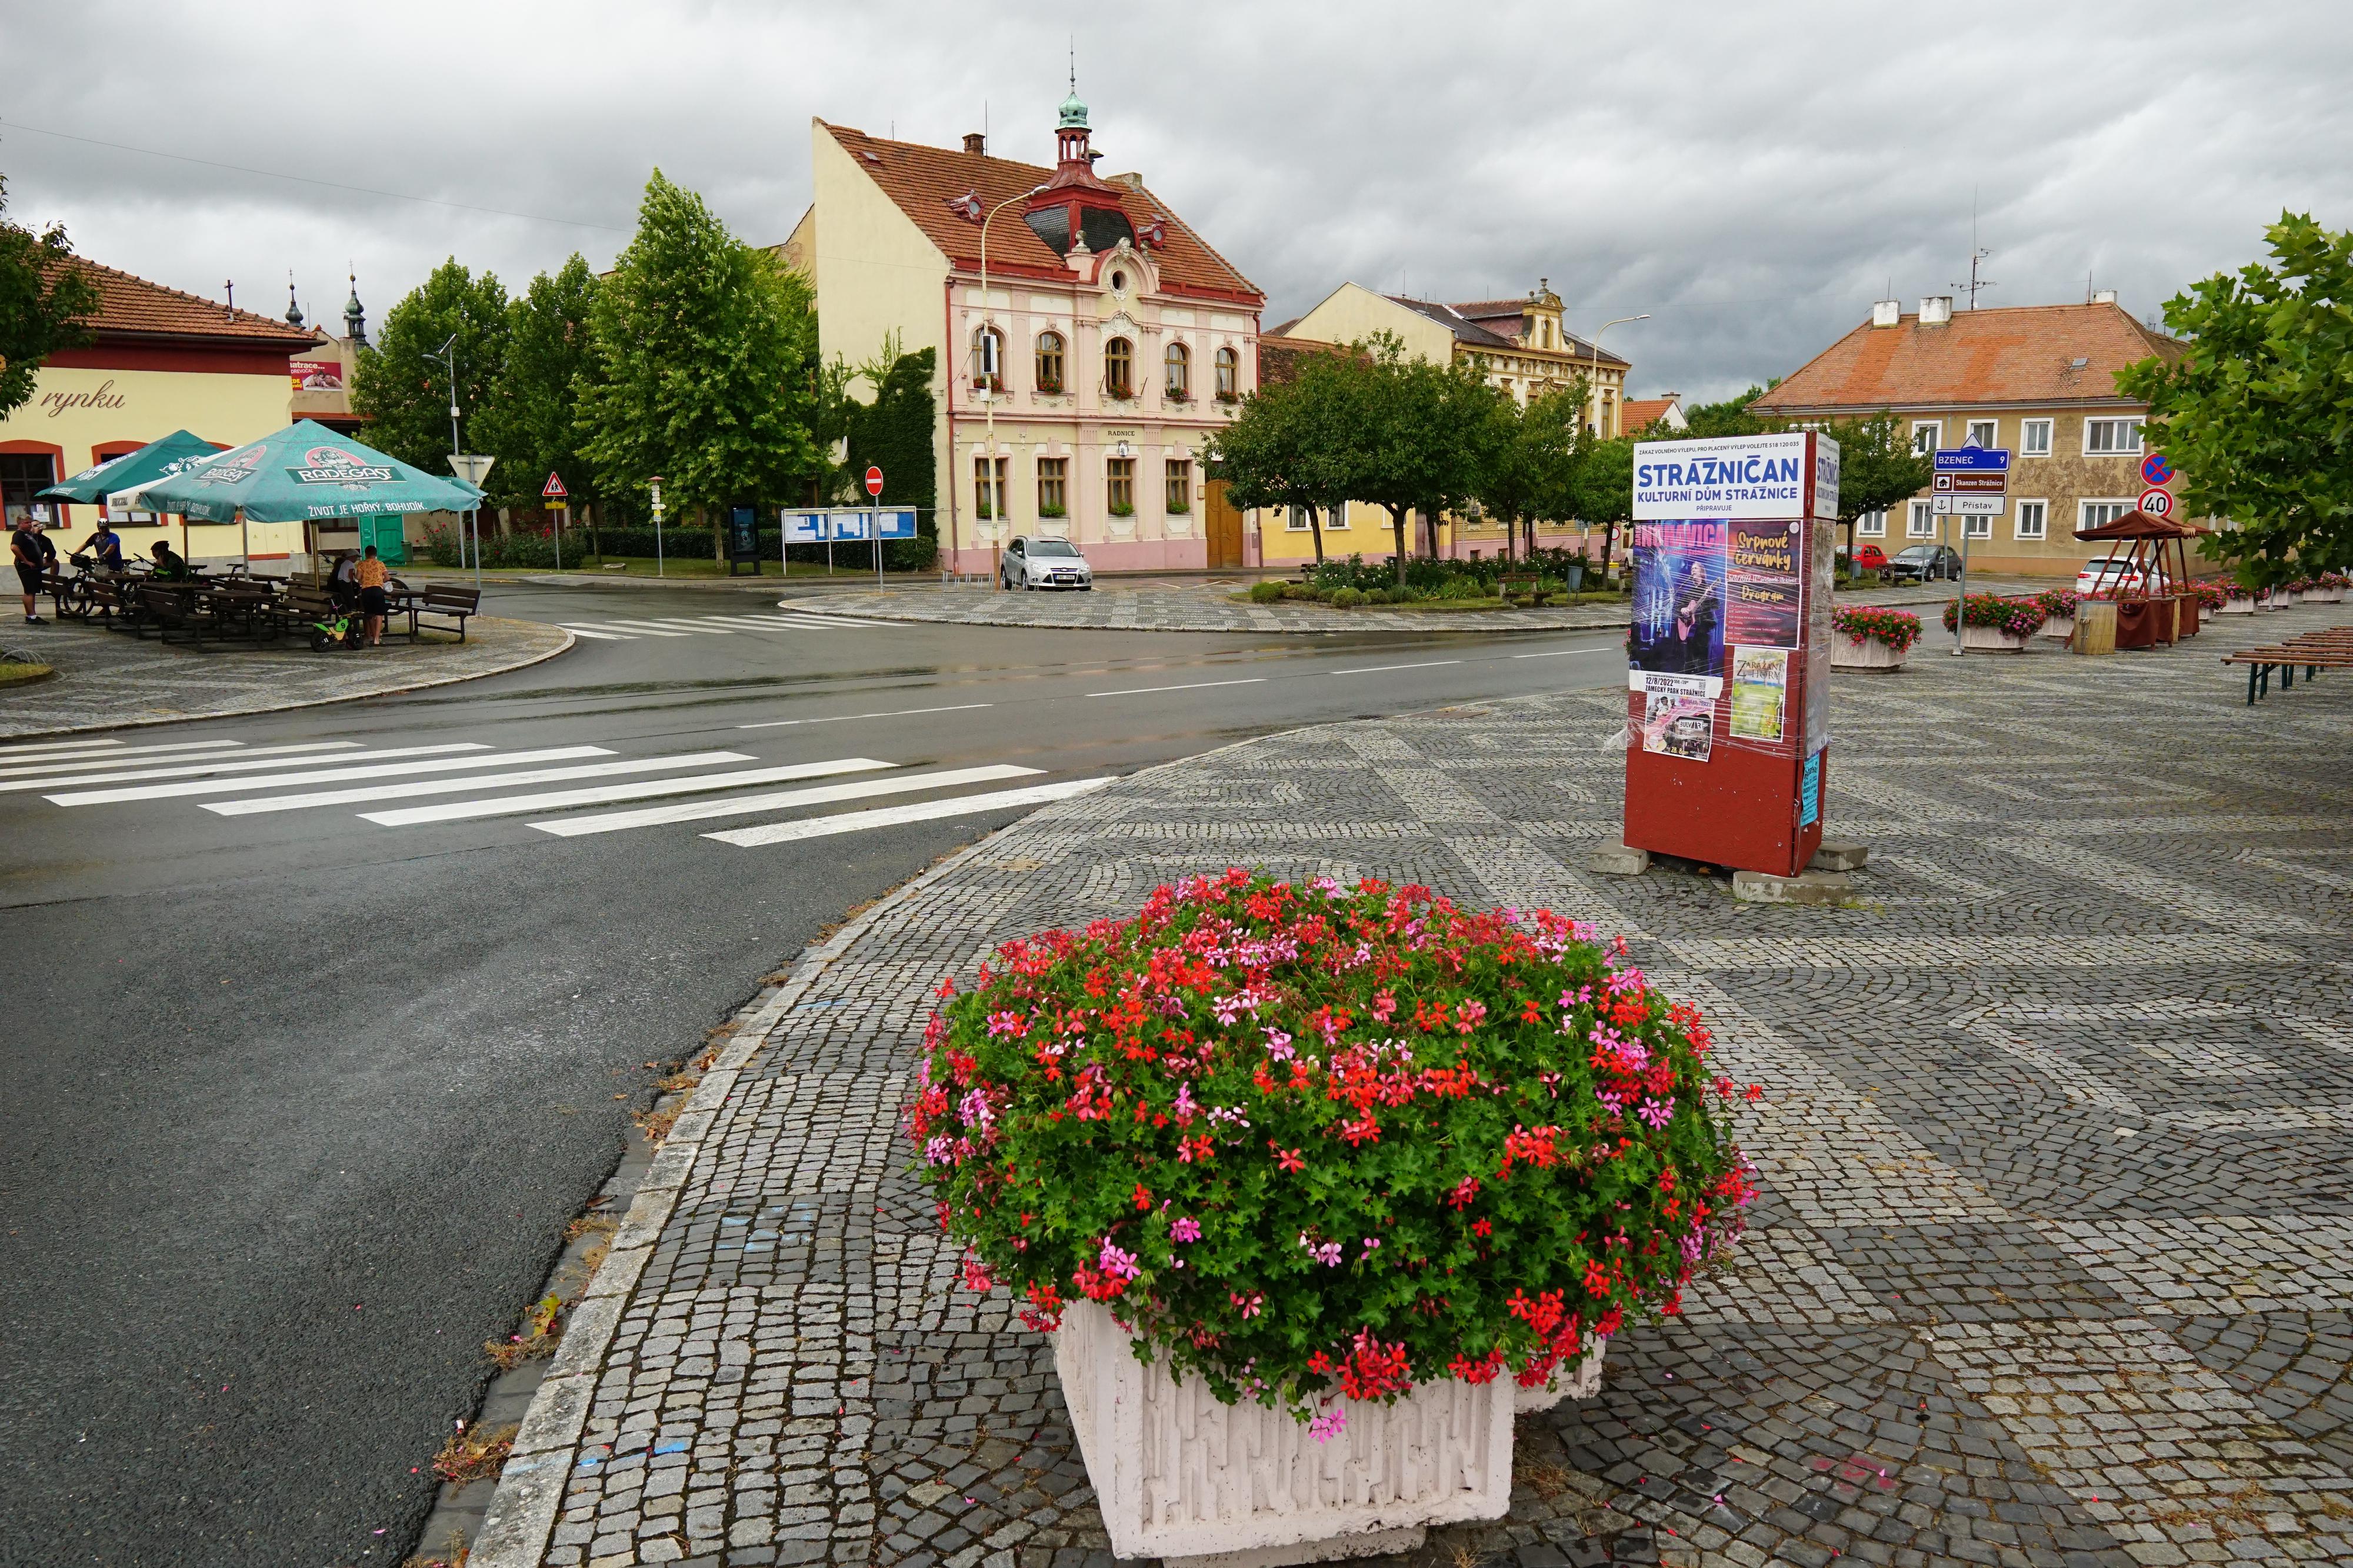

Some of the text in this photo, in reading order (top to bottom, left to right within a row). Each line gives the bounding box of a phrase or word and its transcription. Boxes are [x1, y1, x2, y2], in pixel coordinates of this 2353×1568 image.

[41, 379, 125, 417] rynku
[1999, 456, 2005, 464] 9
[297, 468, 392, 481] RADEGAST
[1638, 489, 1692, 502] KULTURNÍ
[1695, 486, 1721, 501] DŮM
[307, 501, 427, 517] ŽIVOT JE HOŘKÝ. BOHUDÍK.
[2144, 497, 2166, 512] 40
[1738, 531, 1788, 552] Srpnové
[1735, 549, 1791, 571] červánky
[1742, 585, 1784, 602] Program
[1646, 677, 1674, 686] 12/8/2022
[1752, 670, 1781, 680] HORY
[1645, 685, 1667, 693] ZÁMECKÝ
[1680, 688, 1706, 697] STRÁŽNICE
